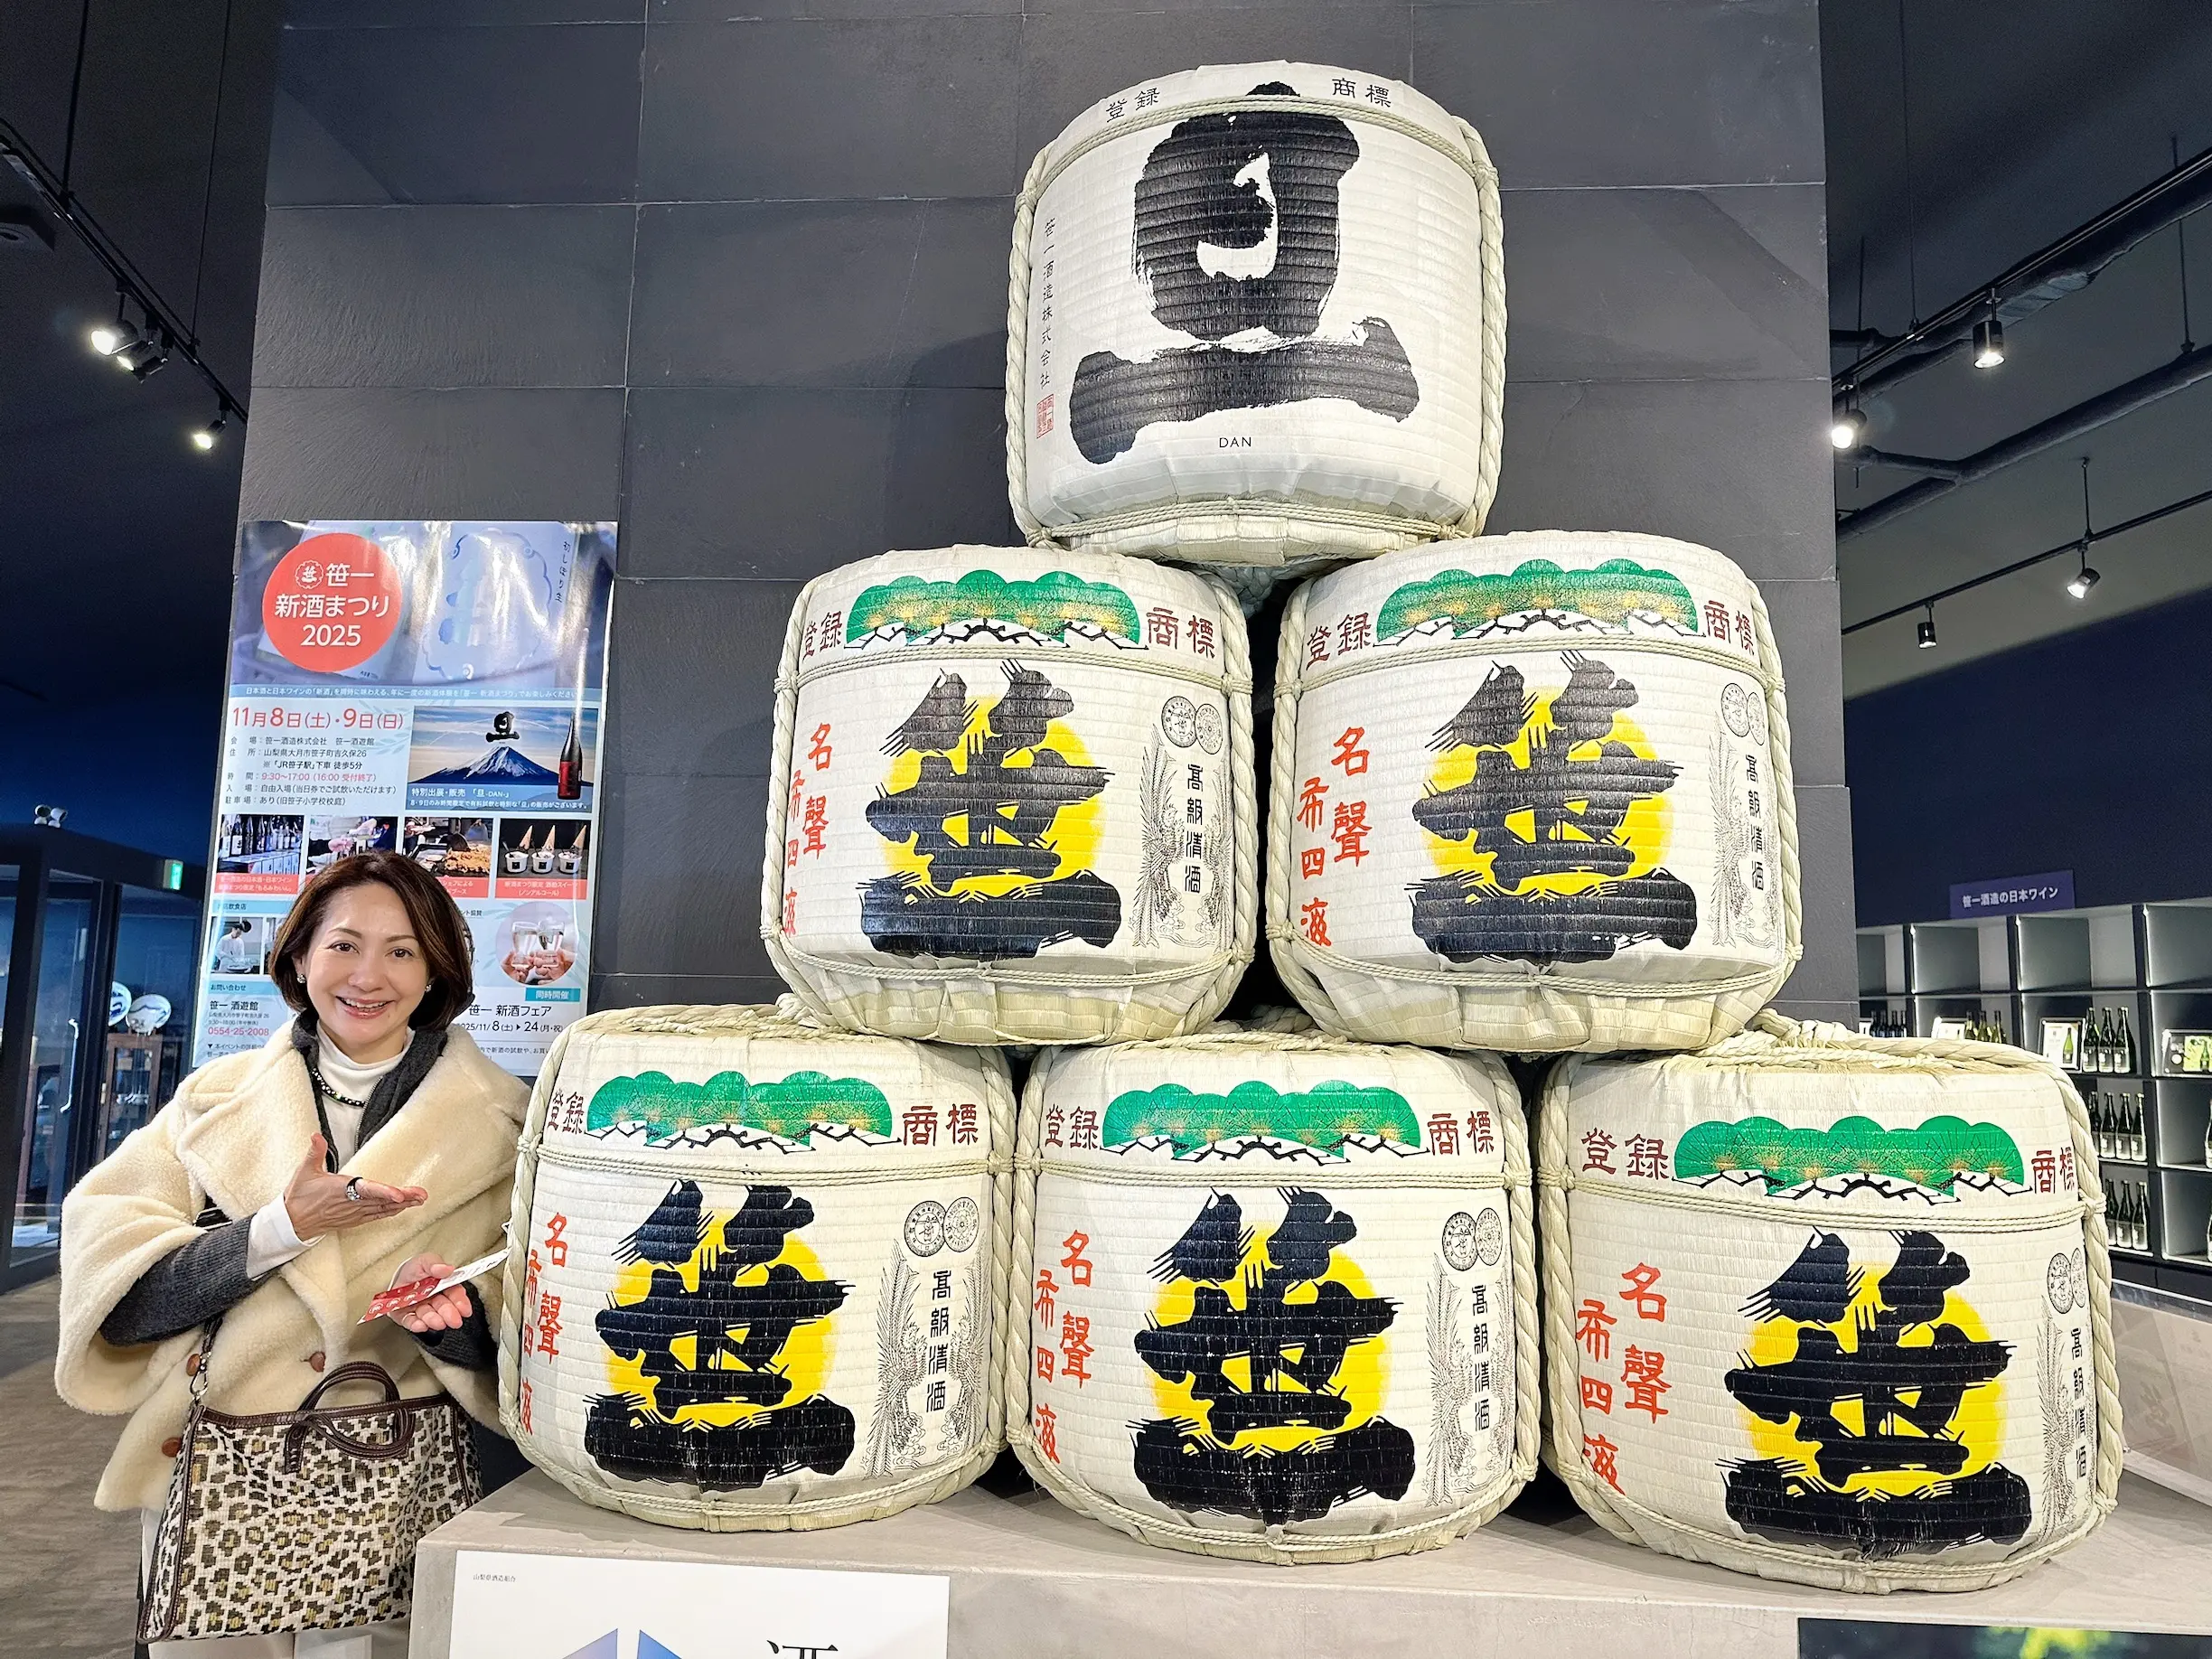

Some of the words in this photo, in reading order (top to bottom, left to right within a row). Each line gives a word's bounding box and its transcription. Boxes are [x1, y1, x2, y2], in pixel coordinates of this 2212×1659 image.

[1105, 87, 1160, 123] 登録
[1331, 77, 1392, 108] 商標
[1218, 436, 1252, 448] DAN
[325, 563, 375, 587] 笹一
[274, 593, 390, 619] 新酒まつり
[300, 623, 362, 647] 2025
[1146, 606, 1215, 659] 商標
[1306, 613, 1372, 671] 登録
[1962, 886, 2058, 908] 笹一酒造の日本ワイン
[210, 1000, 228, 1010] 笹一
[469, 1004, 492, 1017] 笹一
[495, 1004, 552, 1017] 新酒フェア
[208, 1026, 270, 1036] 0554-25-2008
[902, 1102, 979, 1148] 商標
[1044, 1103, 1100, 1150] 登録
[1427, 1110, 1495, 1157] 商標
[1580, 1127, 1673, 1179] 登録
